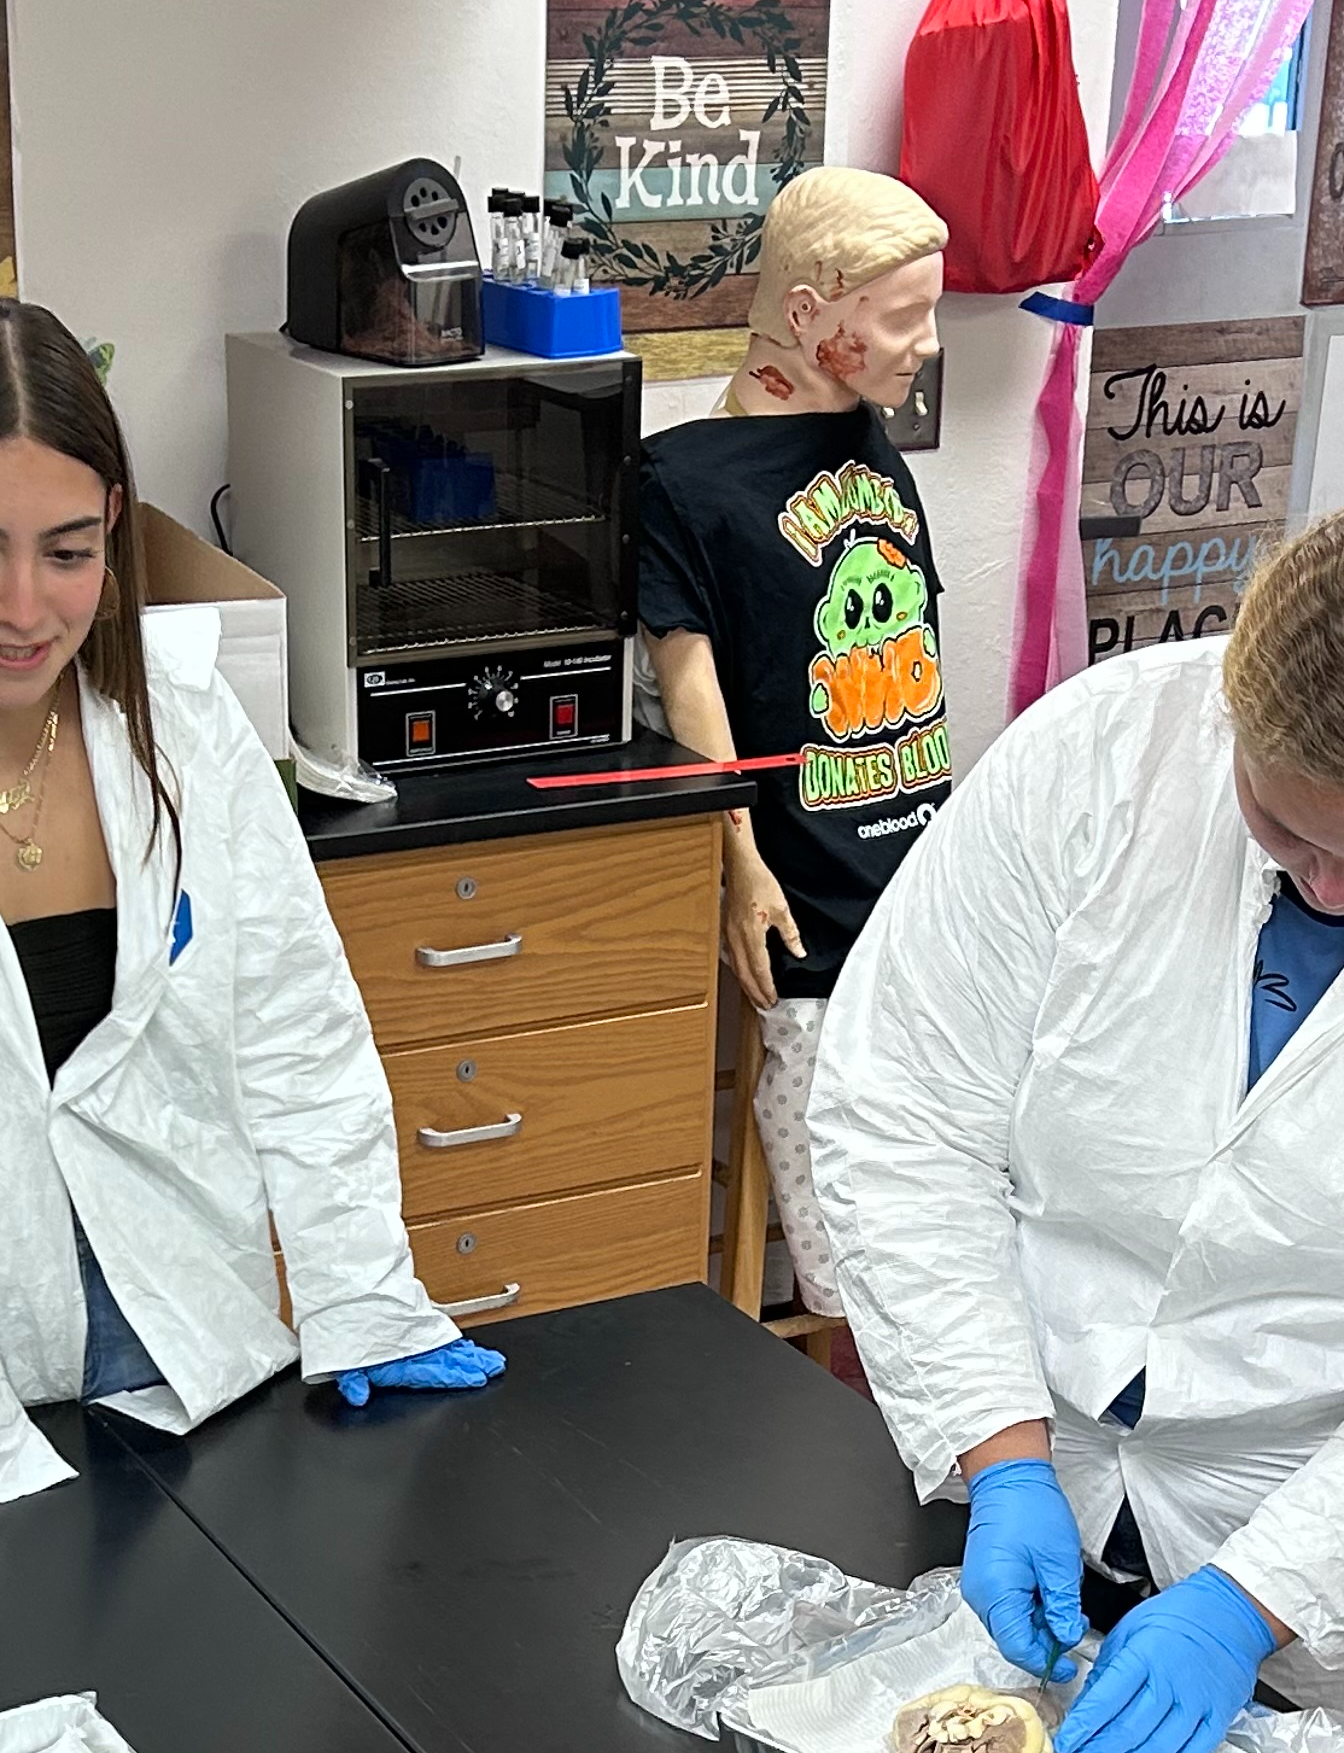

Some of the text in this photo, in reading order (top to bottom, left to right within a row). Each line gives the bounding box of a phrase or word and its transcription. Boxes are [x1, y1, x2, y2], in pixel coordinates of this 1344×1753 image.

[650, 55, 732, 131] Be
[615, 129, 761, 209] Kind
[1105, 363, 1286, 440] This is
[1109, 440, 1263, 519] OUR
[1091, 536, 1257, 606] happy
[804, 724, 951, 804] DONATES BLOO
[857, 811, 919, 839] oneblood
